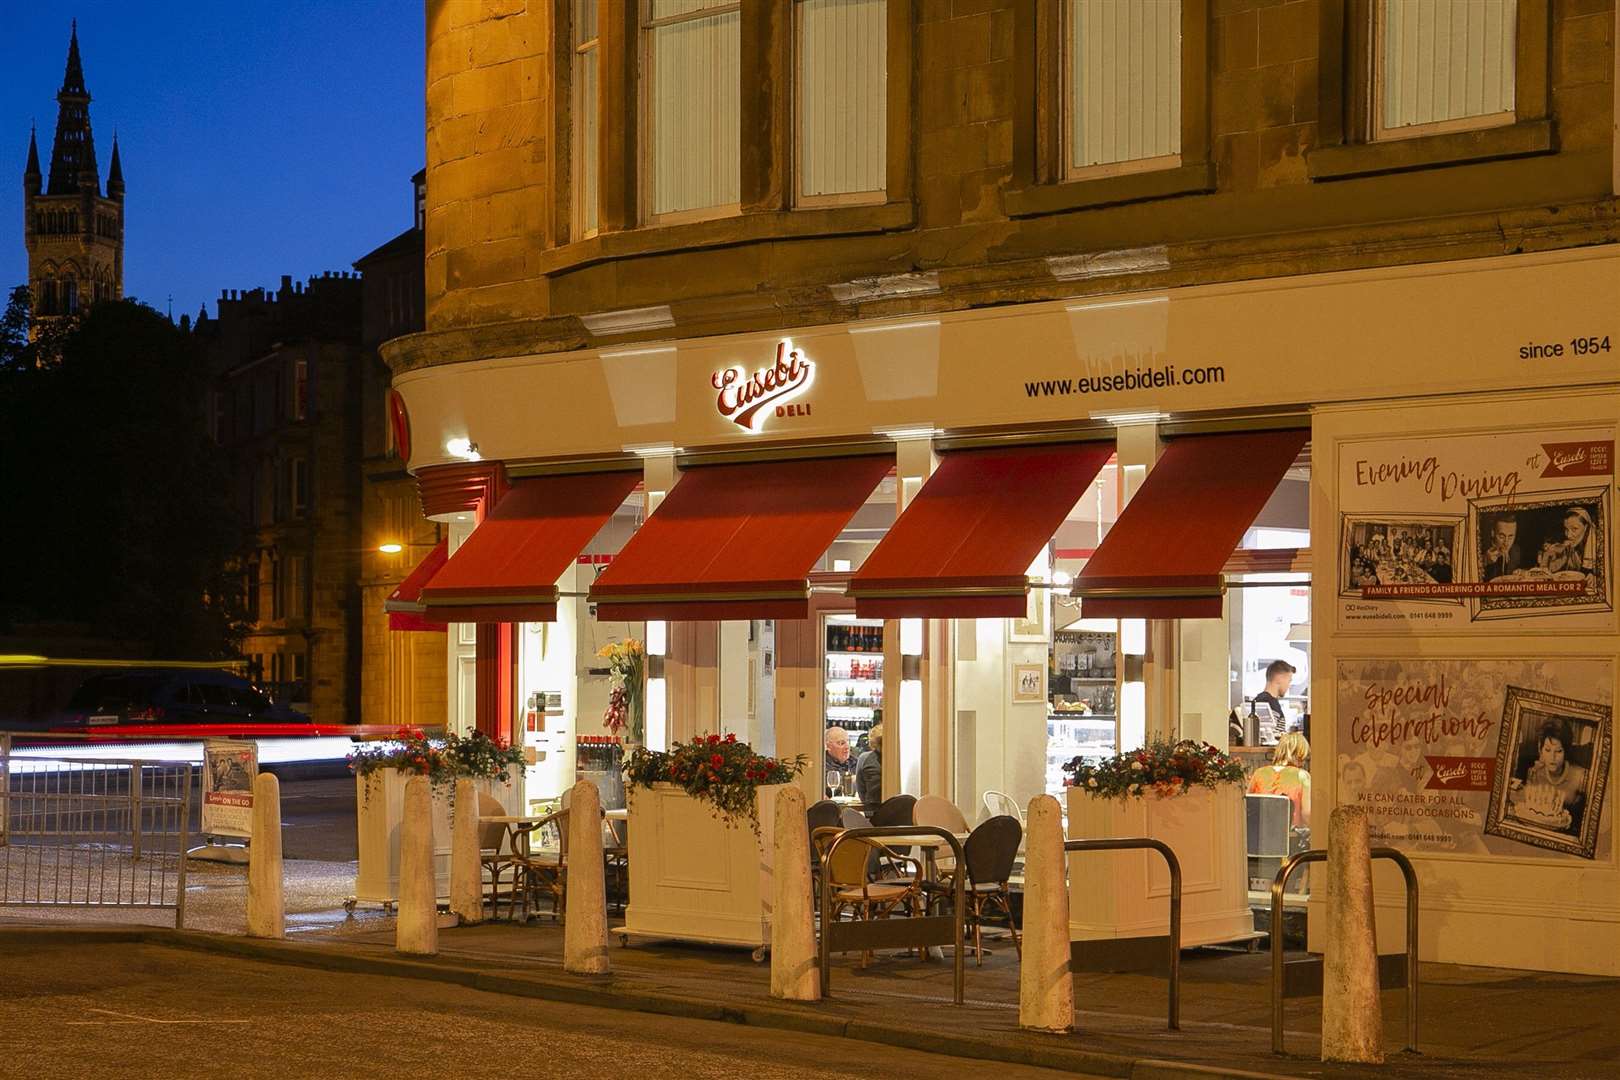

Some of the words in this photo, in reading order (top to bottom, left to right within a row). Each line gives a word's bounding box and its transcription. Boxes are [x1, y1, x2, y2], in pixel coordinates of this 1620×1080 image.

[1519, 339, 1564, 359] since
[1570, 335, 1612, 355] 1954
[711, 341, 812, 428] Eusebi
[1025, 364, 1226, 398] www.eusebideli.com
[775, 403, 812, 418] DELI
[1355, 456, 1440, 494] Evening
[1440, 470, 1522, 505] Dining
[1367, 586, 1392, 595] FAMILY
[1400, 586, 1431, 594] FRIENDS
[1431, 585, 1473, 594] GATHERING
[1475, 584, 1486, 593] OR
[1487, 584, 1493, 593] A
[1494, 583, 1535, 593] ROMANTIC
[1536, 583, 1558, 592] MEAL
[1559, 583, 1574, 592] FOR
[1575, 583, 1582, 591] 2
[1364, 673, 1450, 713] Special
[1351, 709, 1496, 747] Celebrations
[232, 798, 241, 806] THE
[241, 799, 250, 807] GO
[1358, 793, 1373, 802] WE
[1374, 793, 1394, 803] CAN
[1396, 794, 1426, 804] CATER
[1428, 795, 1447, 805] FOR
[1449, 796, 1465, 806] ALL
[1376, 806, 1415, 817] SPECIAL
[1416, 807, 1475, 819] OCCASIONS
